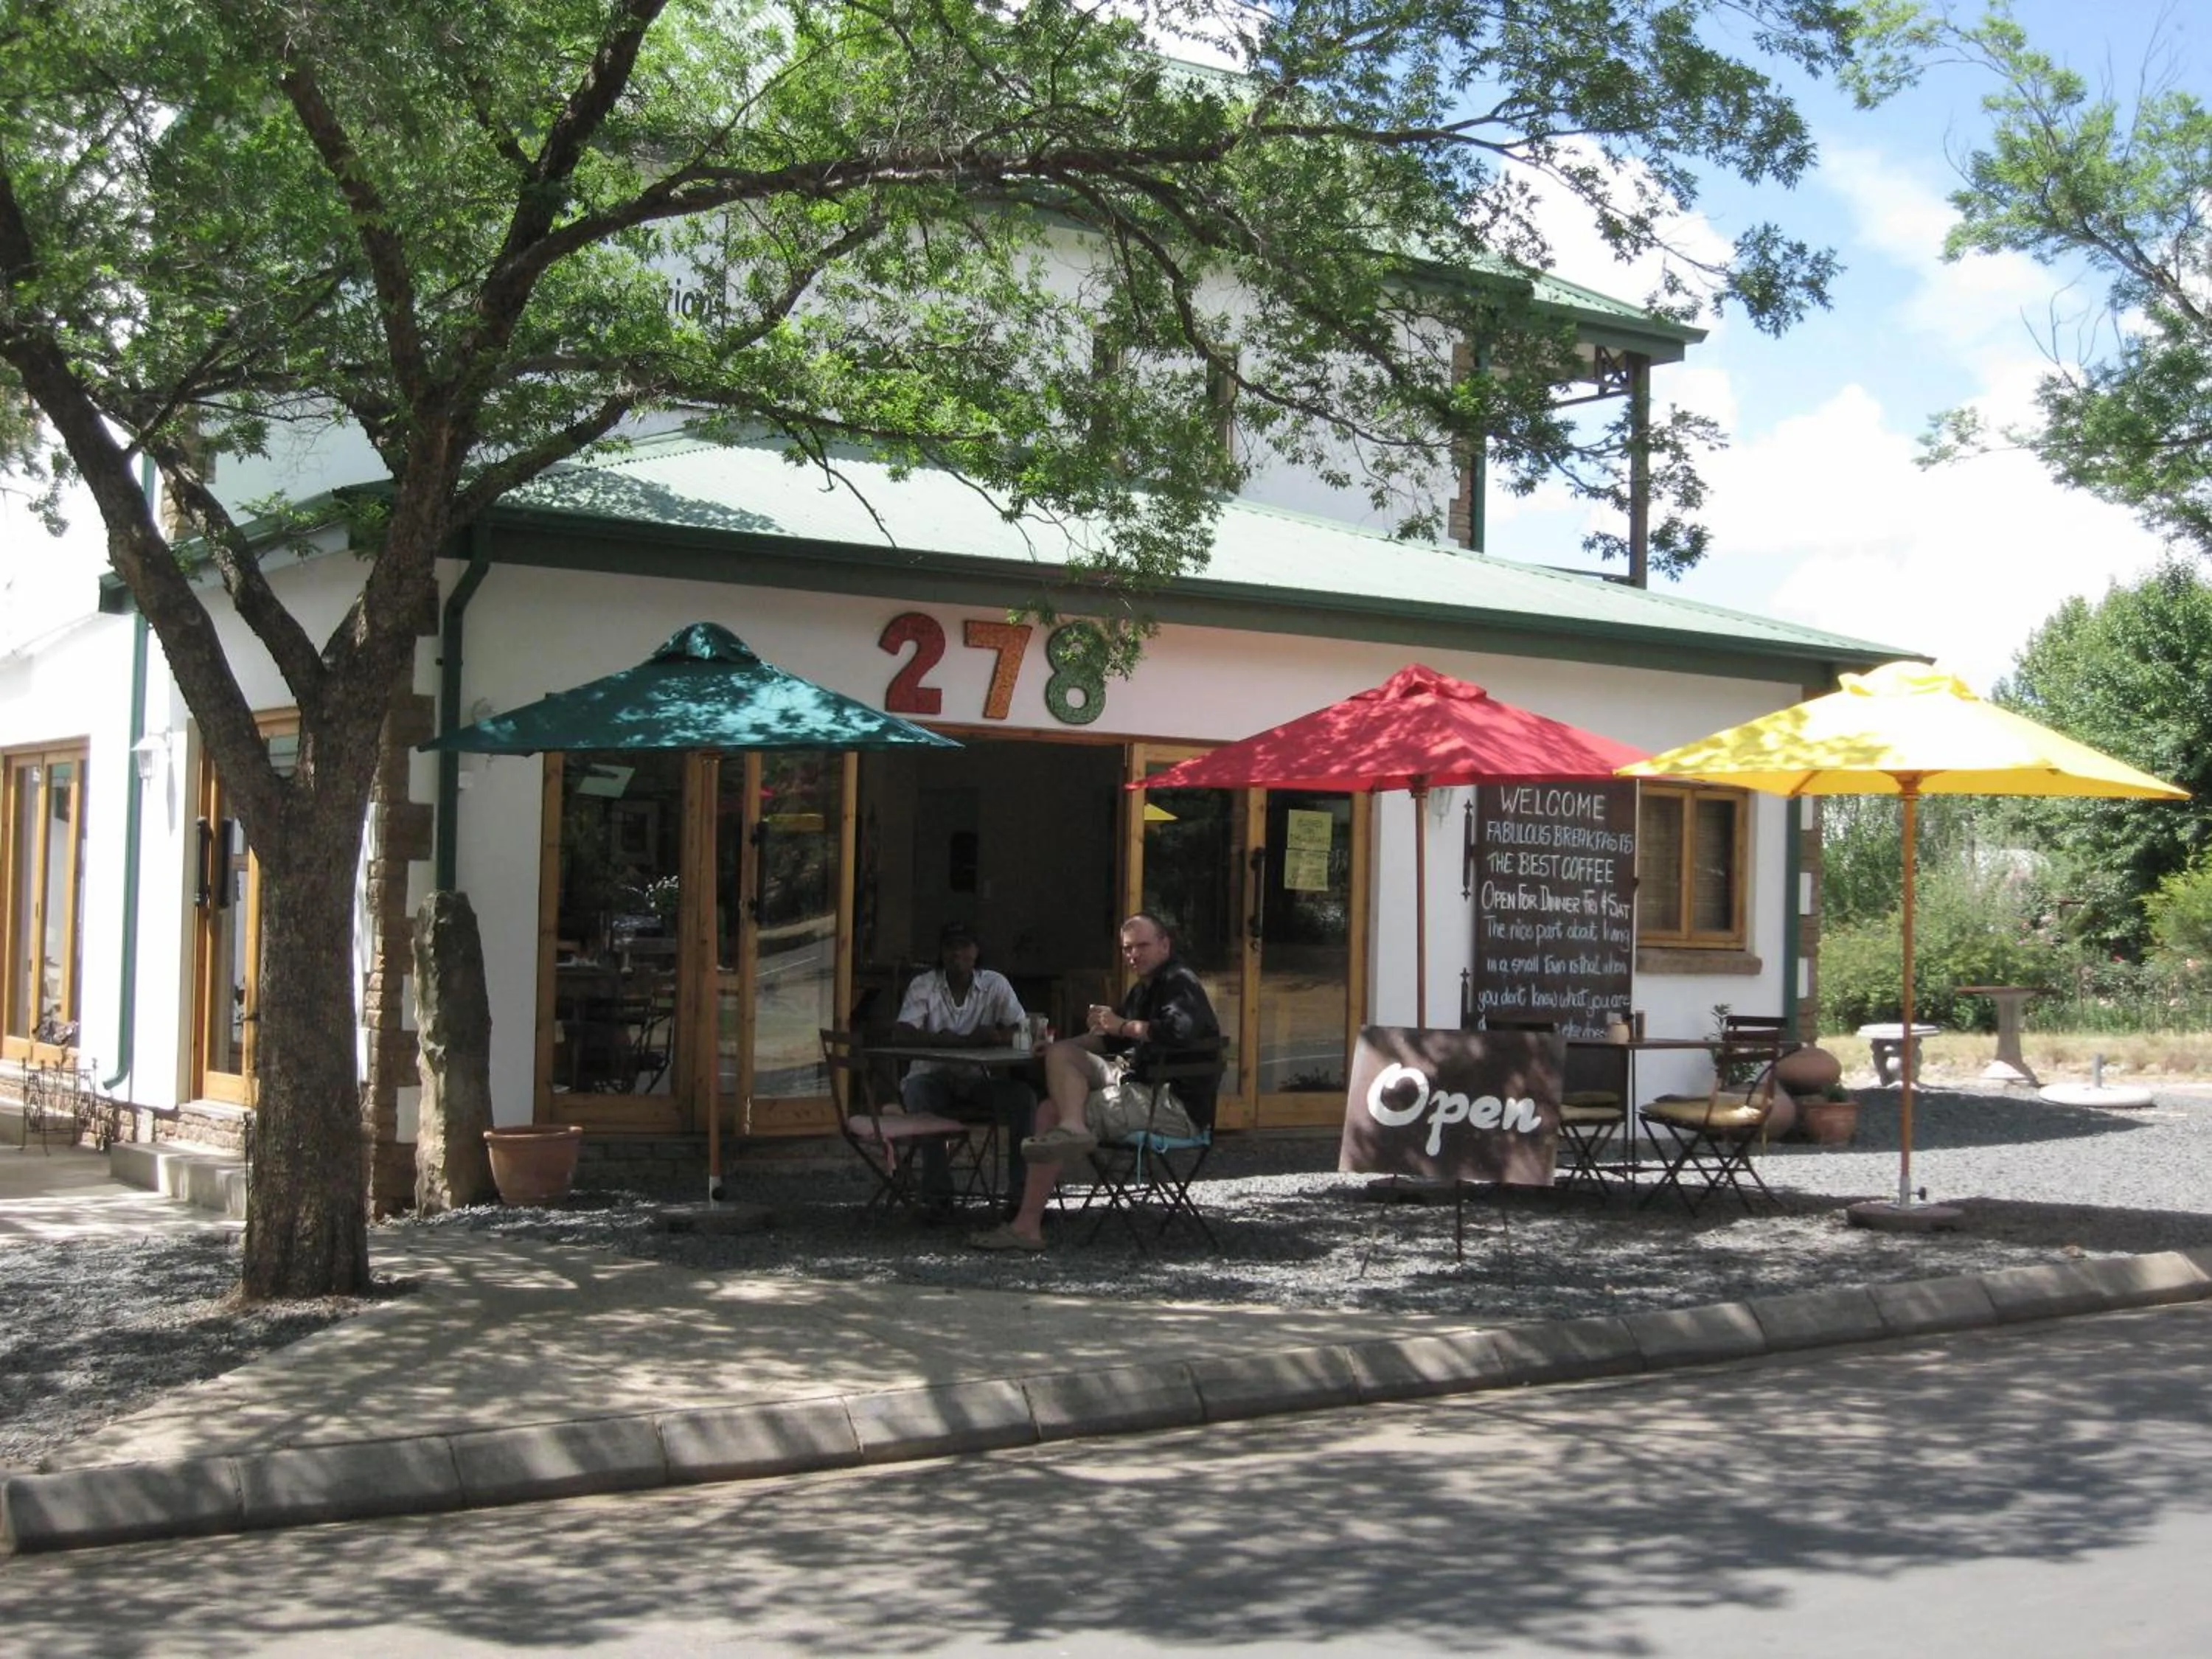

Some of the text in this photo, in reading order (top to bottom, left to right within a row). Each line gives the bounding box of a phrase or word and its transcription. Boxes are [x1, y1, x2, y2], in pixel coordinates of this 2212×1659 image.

[878, 612, 1107, 724] 278
[1500, 785, 1606, 820] WELCOME
[1486, 821, 1633, 855] FABULOUS BREAKFASTS
[1486, 851, 1615, 883] THE BEST COFFEE
[1482, 915, 1506, 939] The
[1535, 919, 1563, 947] part
[1498, 958, 1509, 973] a
[1510, 954, 1540, 975] small
[1477, 990, 1499, 1013] you
[1366, 1062, 1542, 1157] Open
